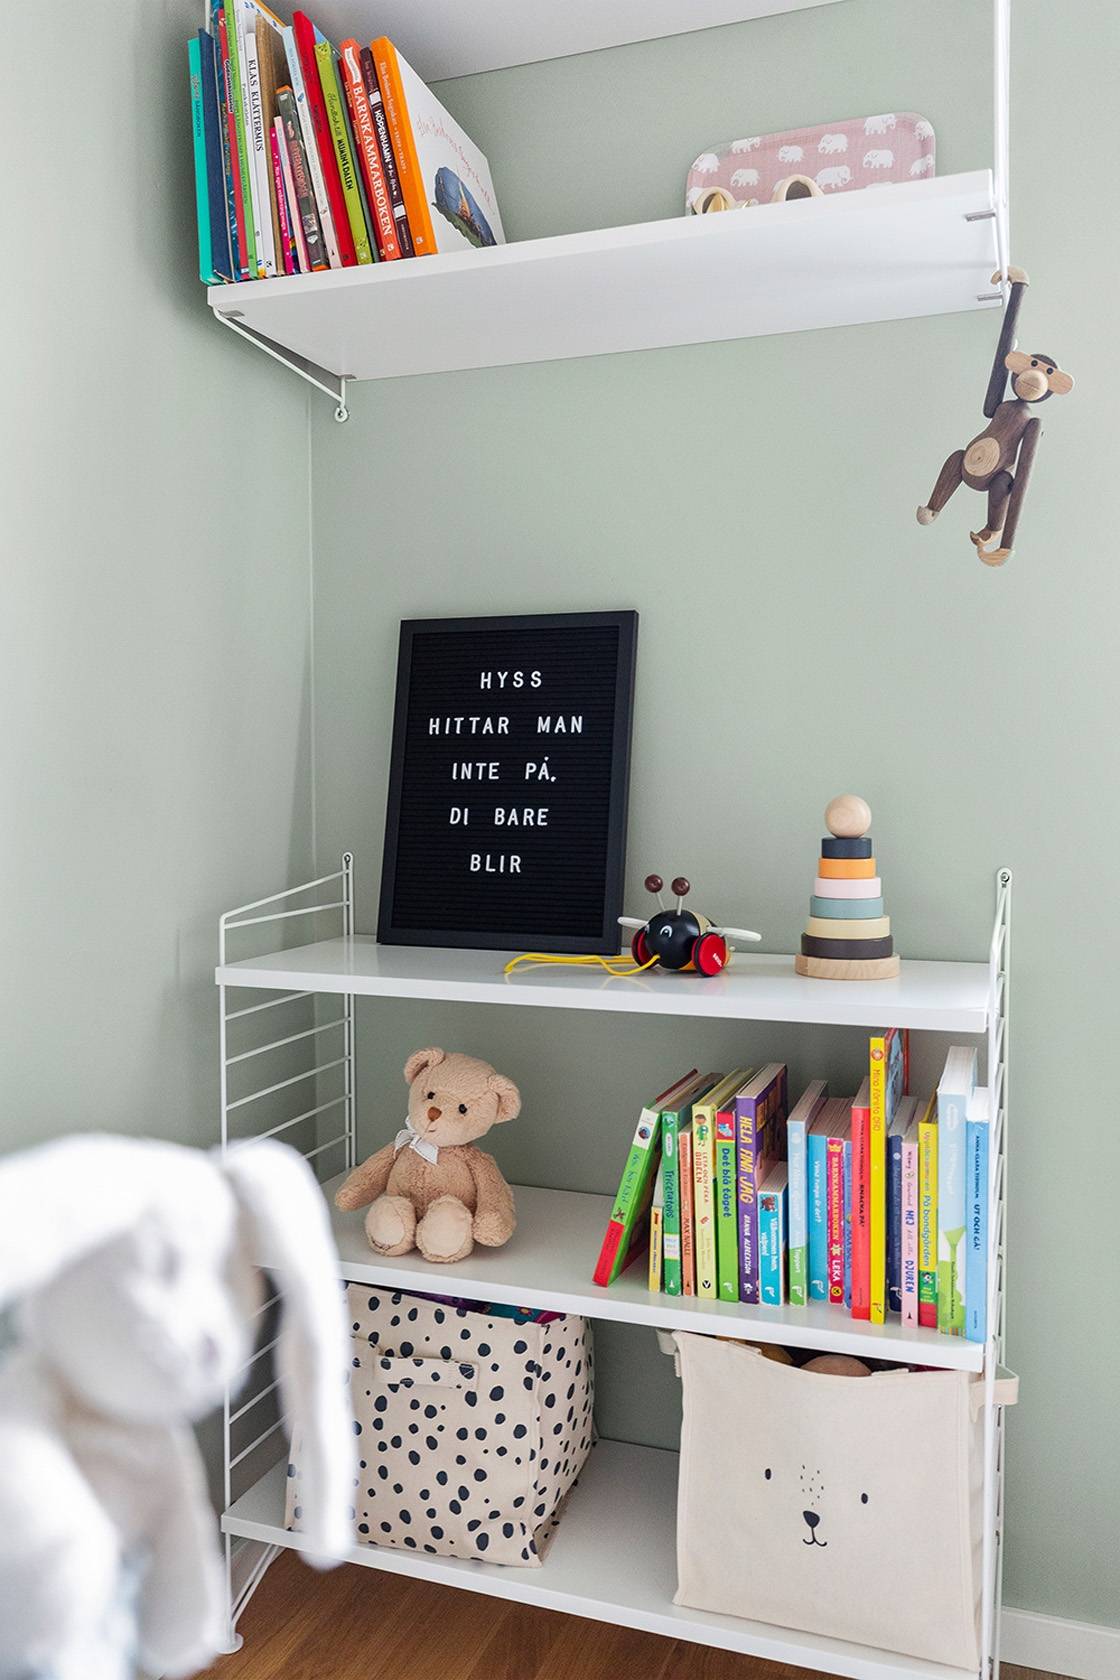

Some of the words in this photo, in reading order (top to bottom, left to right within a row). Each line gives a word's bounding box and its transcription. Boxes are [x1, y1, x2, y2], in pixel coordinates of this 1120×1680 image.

[248, 59, 258, 87] KLAS
[374, 109, 391, 163] KÖPENHAMN
[353, 86, 393, 236] BARNKAMMARBOKEN
[480, 671, 542, 690] HYSS
[428, 716, 510, 735] HITTAR
[537, 715, 583, 734] MAN
[452, 762, 500, 780] INTE
[450, 807, 469, 826] DI
[494, 807, 550, 827] BARE
[470, 854, 522, 874] BLIR
[740, 1115, 753, 1144] HELA
[722, 1148, 731, 1167] Det
[740, 1147, 754, 1174] FINA
[722, 1168, 732, 1185] blå
[740, 1176, 754, 1204] JAG
[722, 1187, 732, 1218] tåget
[922, 1195, 931, 1211] På
[973, 1203, 981, 1215] UT
[905, 1209, 915, 1226] HEJ
[973, 1216, 981, 1234] OCH
[683, 1234, 691, 1256] NALLE
[770, 1217, 778, 1255] Välkommen
[922, 1212, 932, 1266] bondgården
[973, 1235, 981, 1250] GÅ!
[831, 1260, 842, 1281] LEKA
[905, 1260, 914, 1293] DJUREN
